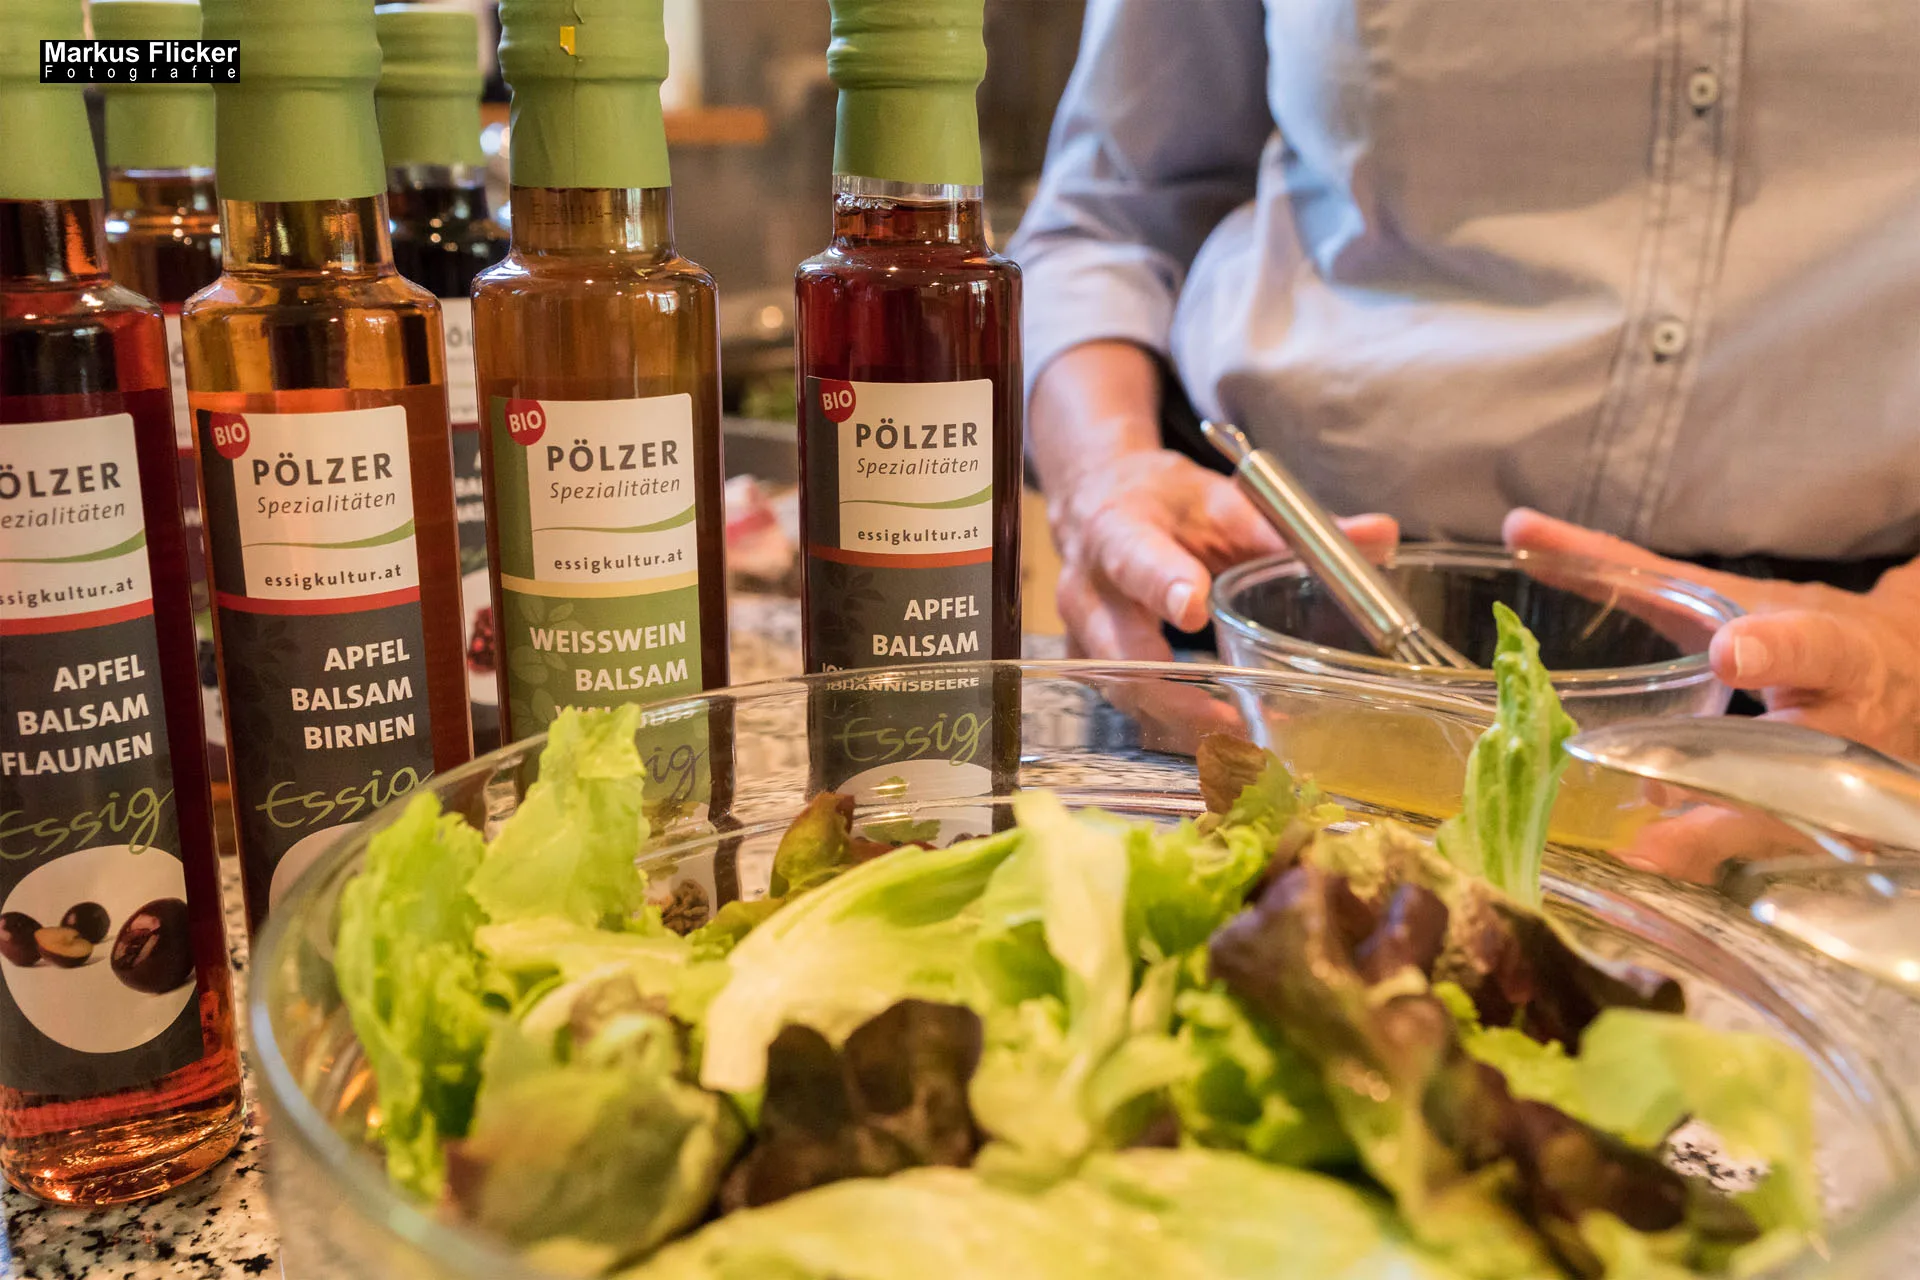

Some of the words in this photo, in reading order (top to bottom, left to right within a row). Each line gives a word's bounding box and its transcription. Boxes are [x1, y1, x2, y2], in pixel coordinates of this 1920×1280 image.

[822, 389, 853, 411] BIO
[214, 423, 246, 446] BIO
[508, 410, 542, 433] BIO
[856, 418, 978, 450] PÖLZER
[252, 452, 393, 486] PÖLZER
[547, 439, 679, 472] PÖLZER
[857, 456, 979, 478] Spezialitäten
[257, 491, 397, 519] Spezialitäten
[550, 477, 681, 504] Spezialitäten
[857, 525, 979, 546] essigkultur.at
[554, 548, 684, 574] essigkultur.at
[264, 564, 402, 591] essigkultur.at
[904, 594, 980, 621] APFEL
[529, 620, 687, 654] WEISSWEIN
[872, 630, 980, 657] BALSAM
[323, 638, 411, 672] APFEL
[53, 654, 145, 692] APFEL
[575, 658, 689, 691] BALSAM
[291, 676, 413, 711] BALSAM
[17, 693, 150, 735] BALSAM
[303, 713, 416, 750] BIRNEN
[832, 712, 993, 767] Essig
[1, 731, 154, 776] FLAUMEN
